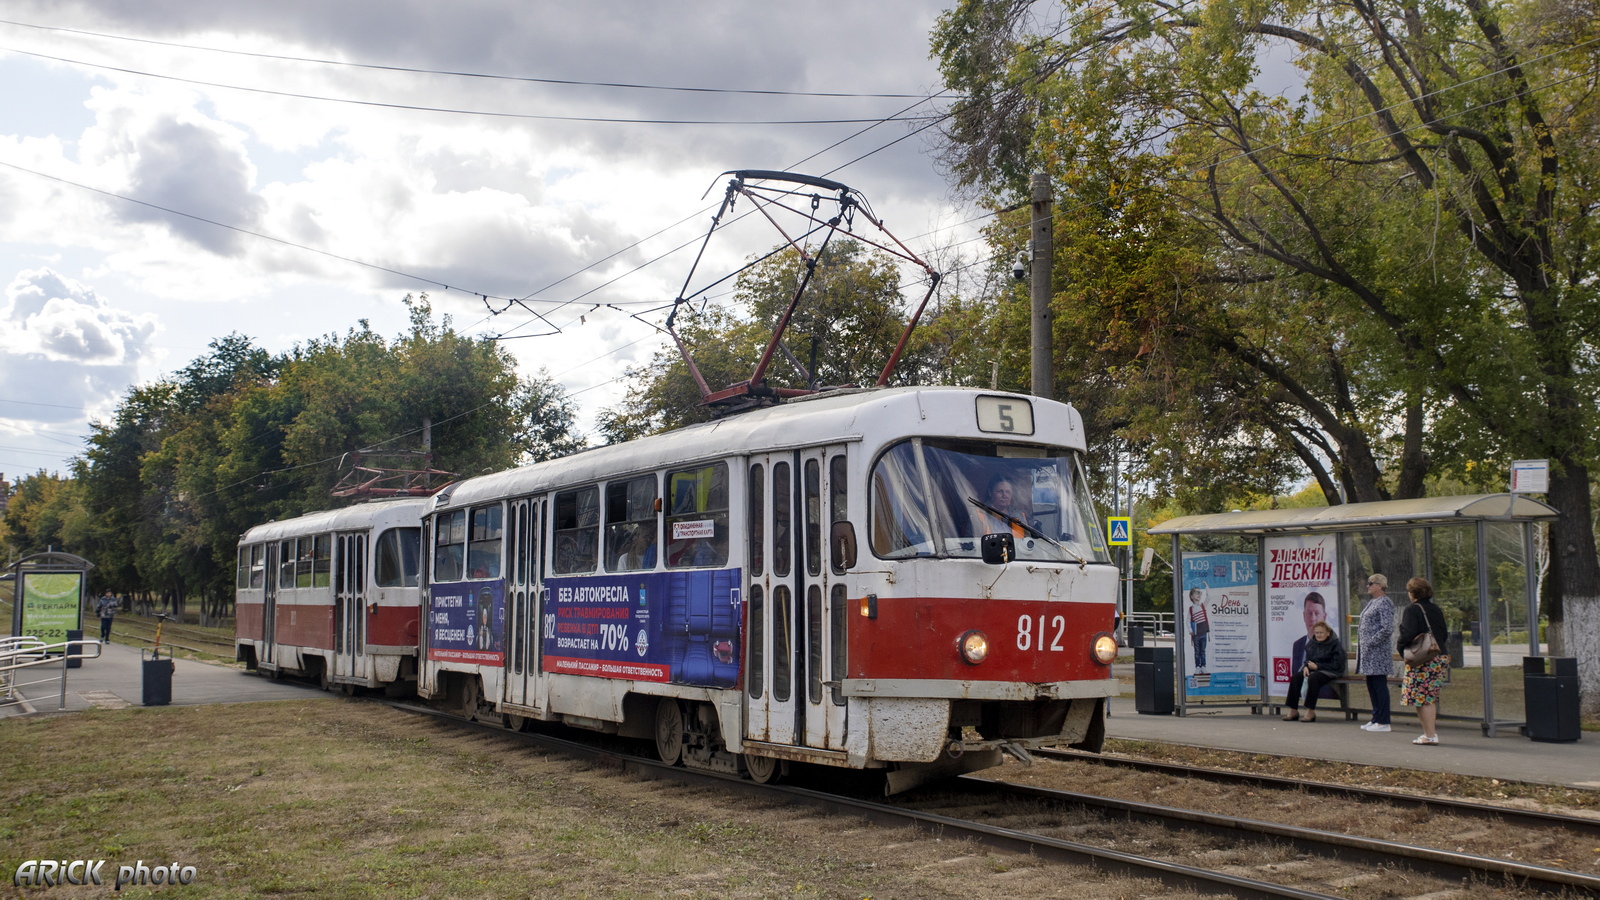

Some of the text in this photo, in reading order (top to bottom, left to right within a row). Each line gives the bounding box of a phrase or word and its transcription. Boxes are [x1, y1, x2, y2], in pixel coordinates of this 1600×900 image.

[998, 404, 1015, 432] 5
[1277, 546, 1325, 562] АЛЕКСЕЙ
[1188, 559, 1210, 571] 1.09
[1272, 562, 1333, 581] ЛЕСКИН
[434, 595, 463, 608] ПРИСТЕГНИ
[558, 585, 630, 603] БЕЗ АВТОКРЕСЛА
[1220, 594, 1241, 609] День
[557, 607, 573, 619] РИСК
[573, 607, 630, 620] ТРАВМИРОВАНИЯ
[1211, 603, 1249, 615] Знаний
[434, 612, 450, 626] МЕНЯ,
[543, 613, 556, 639] 812
[434, 628, 466, 643] Я БЕСЦЕНЕН!
[557, 622, 599, 636] РЕБЕНКА В ДТП
[1016, 614, 1066, 652] 812
[557, 637, 599, 651] ВОЗРАСТАЕТ НА
[599, 623, 630, 652] 70%
[556, 659, 579, 670] МАЛЕНЬКИЙ
[578, 662, 600, 672] ПАССАЖИР
[601, 664, 622, 673] БОЛЬШАЯ
[622, 665, 664, 677] ОТВЕТСТВЕННОСТЬ
